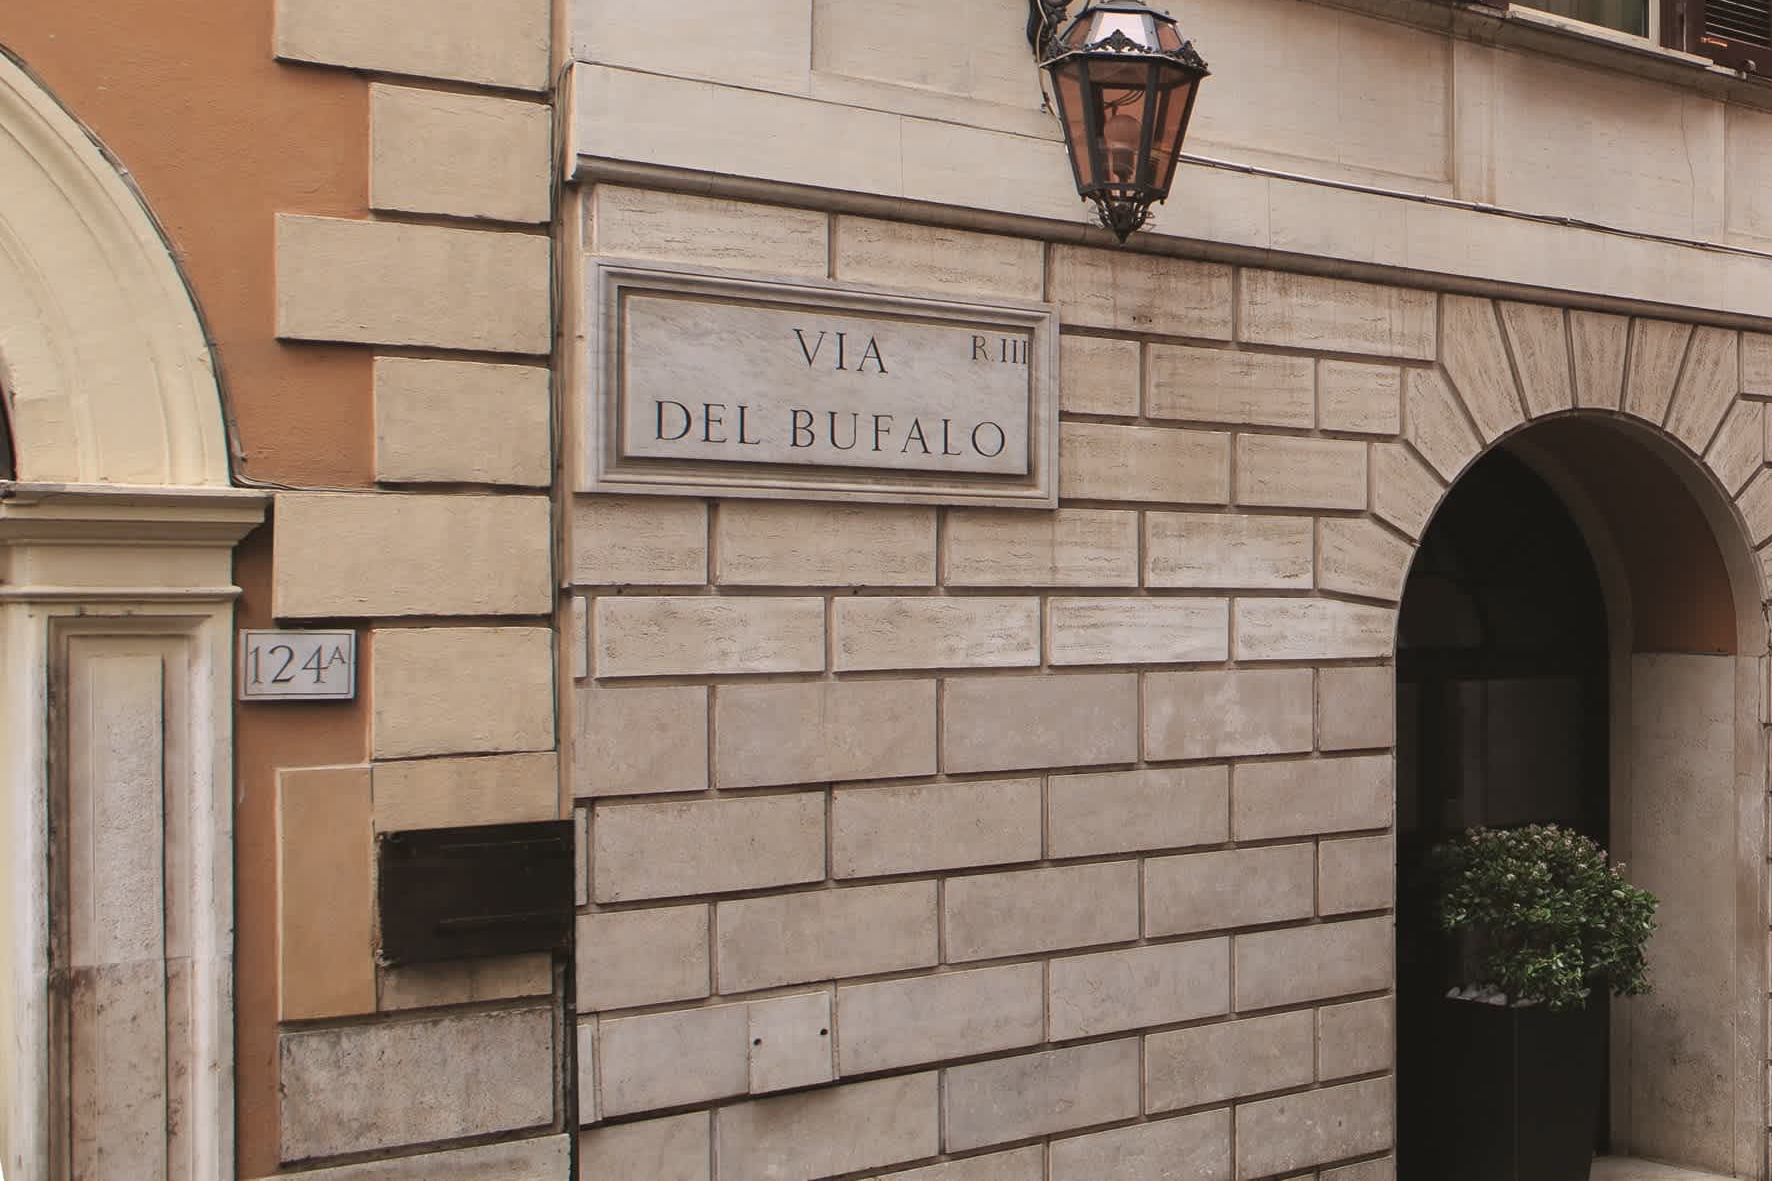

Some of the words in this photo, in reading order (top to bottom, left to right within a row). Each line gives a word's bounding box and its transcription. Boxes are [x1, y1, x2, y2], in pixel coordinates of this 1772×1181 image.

[793, 328, 889, 374] VIA
[654, 399, 761, 446] DEL
[789, 408, 1006, 458] BUFALO
